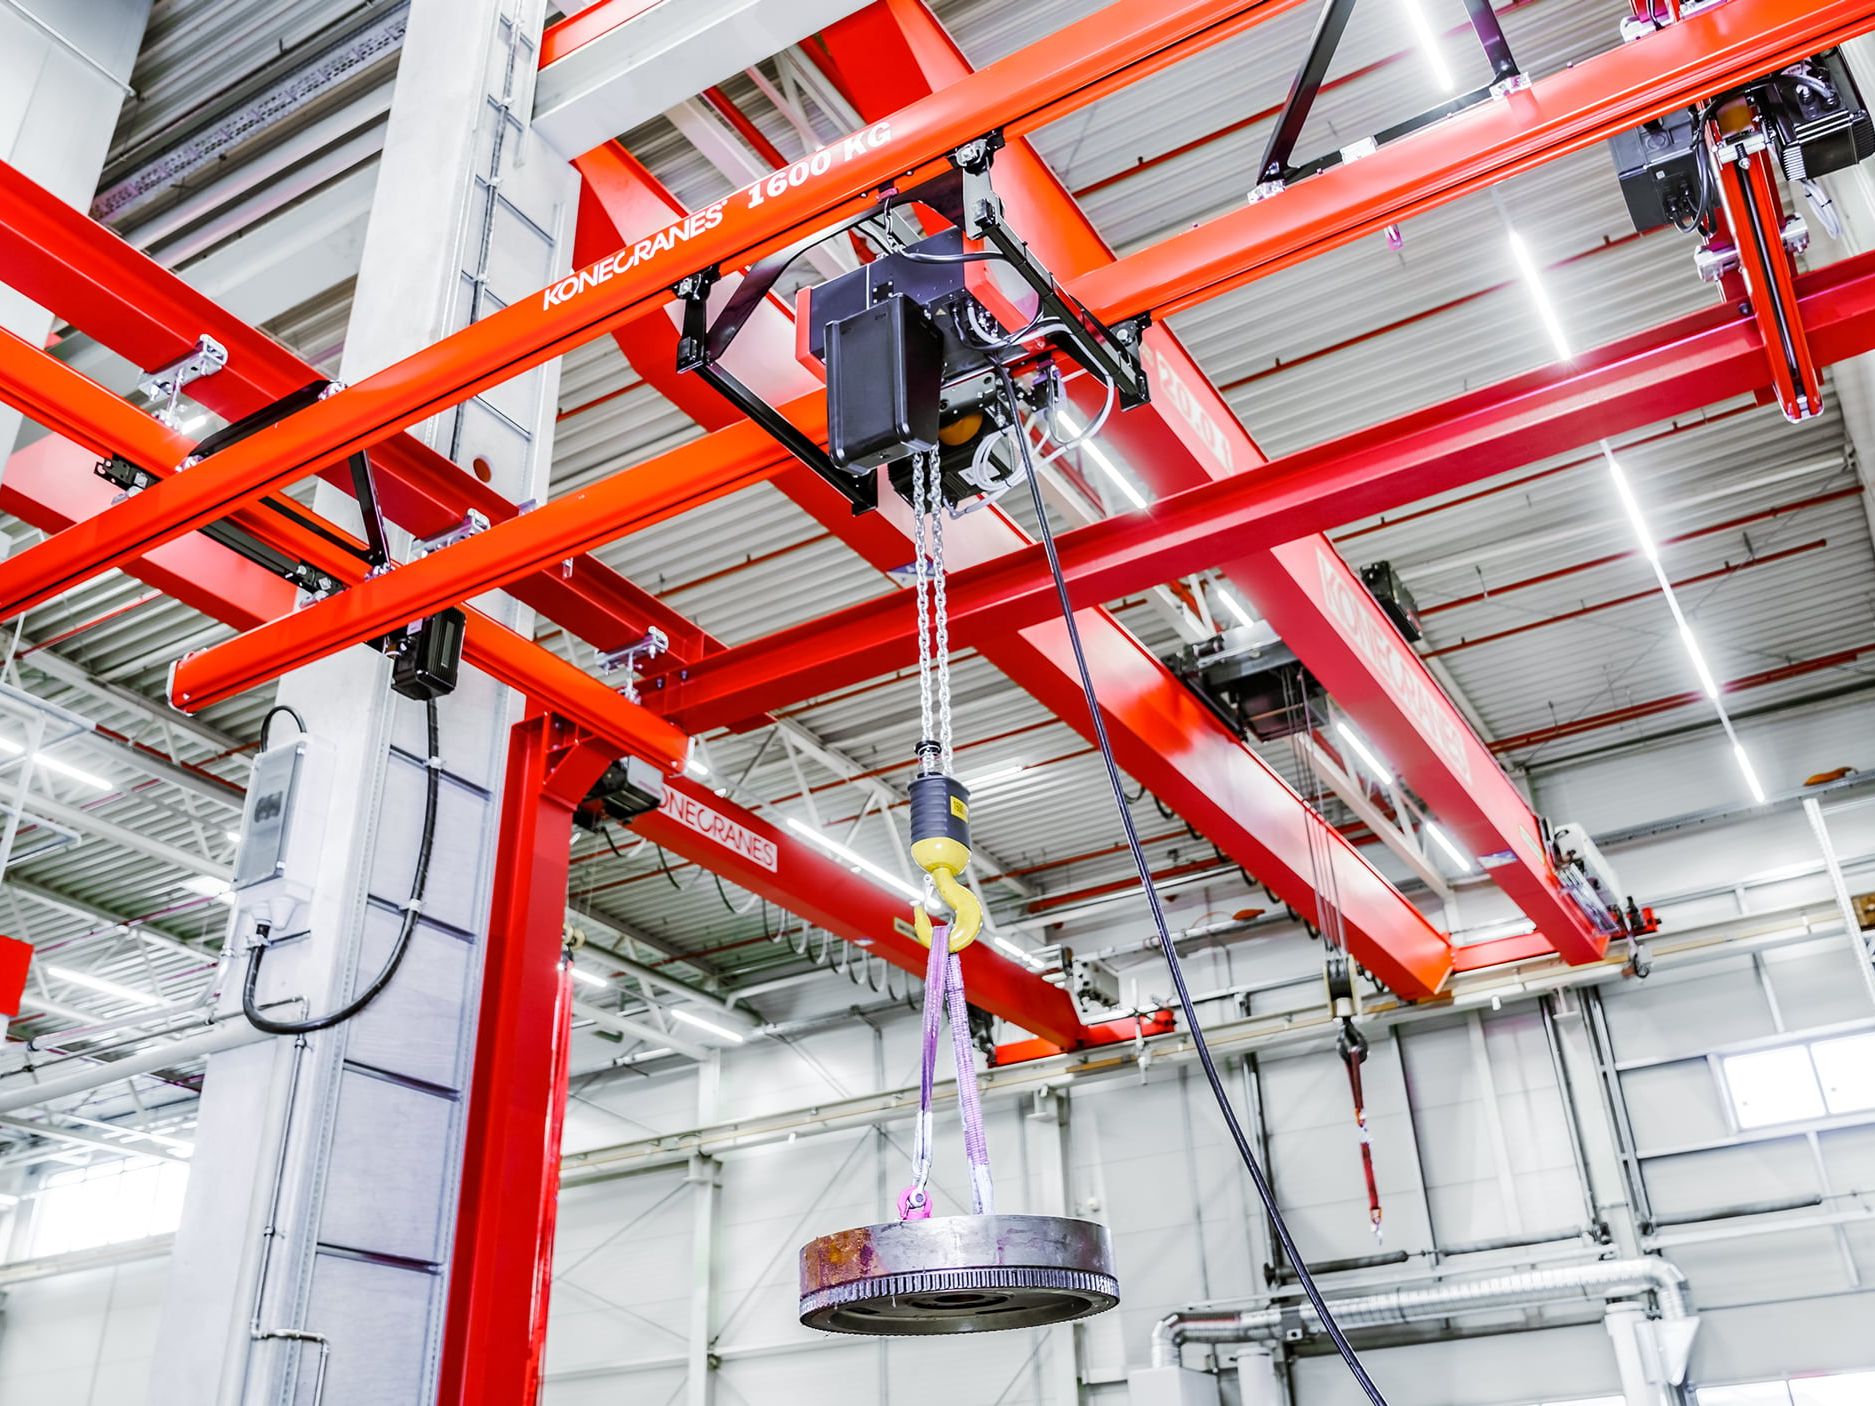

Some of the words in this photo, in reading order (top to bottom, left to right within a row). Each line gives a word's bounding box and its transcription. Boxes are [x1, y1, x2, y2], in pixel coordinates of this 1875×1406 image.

[543, 203, 725, 311] KONECRANES
[747, 152, 833, 209] 1600
[843, 121, 893, 162] KG
[657, 786, 773, 867] ONECRANES
